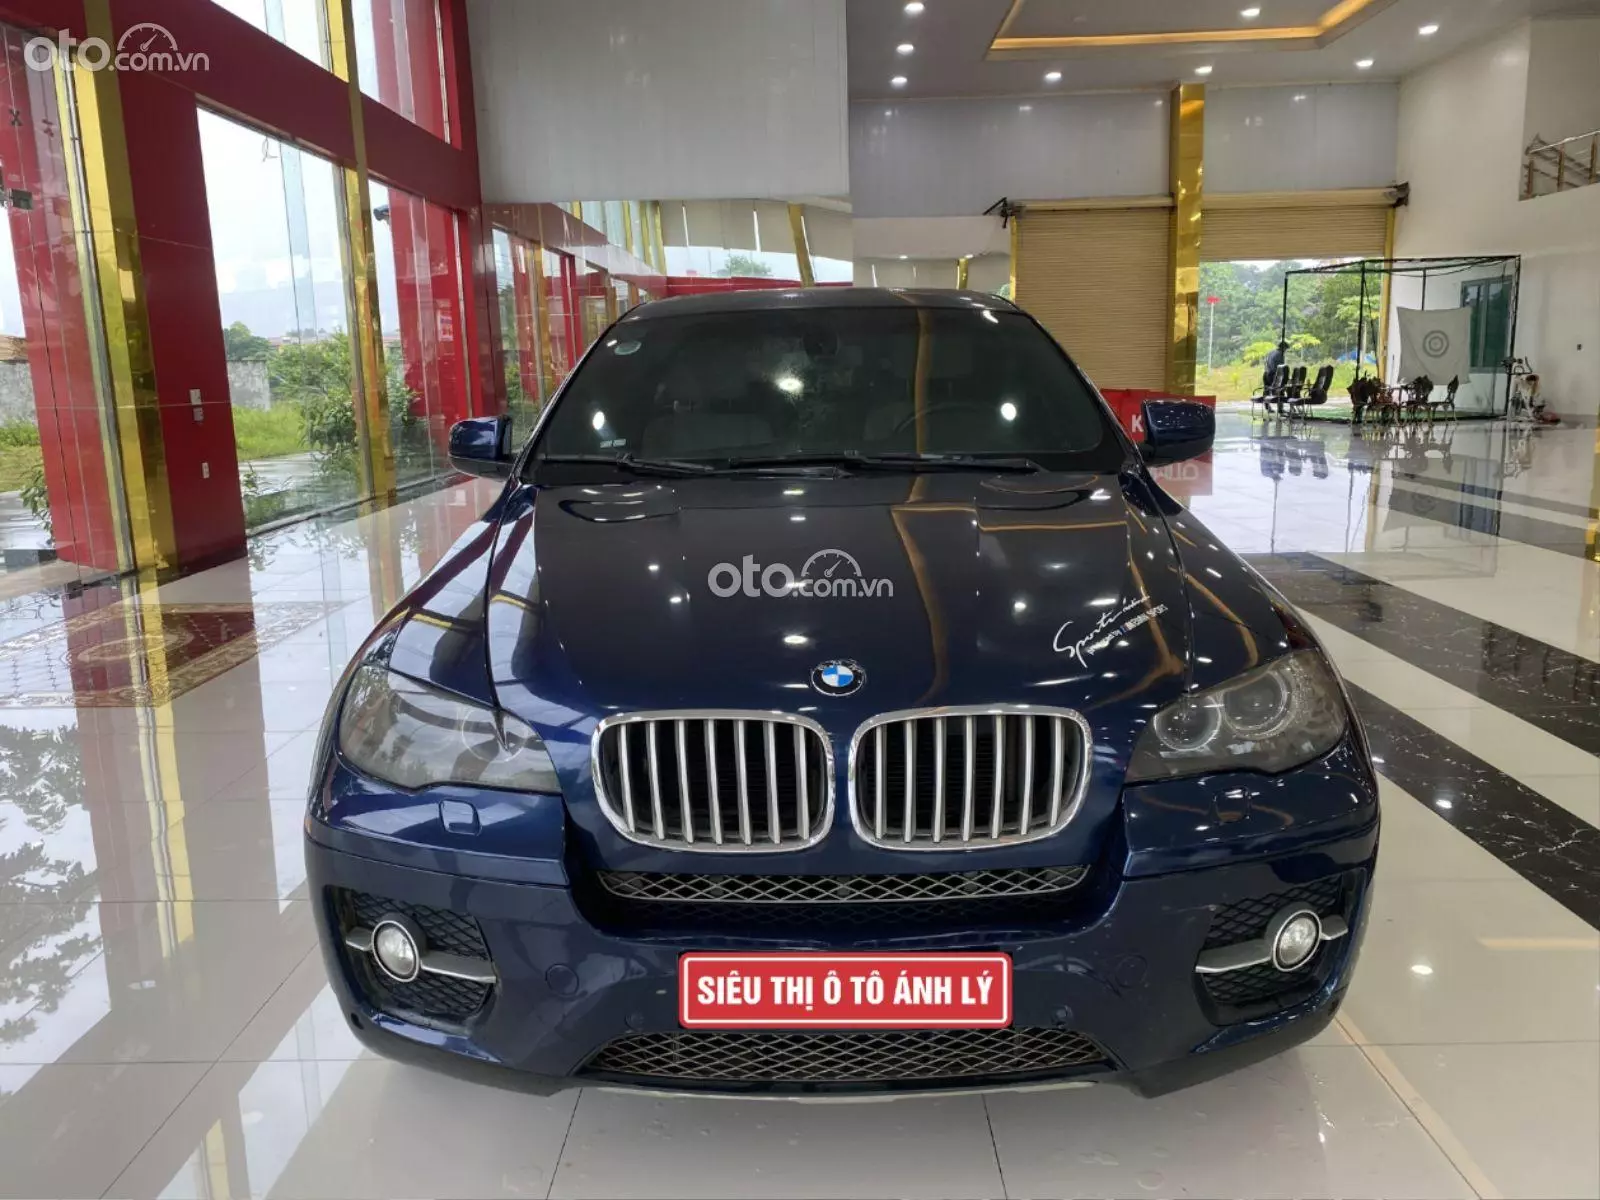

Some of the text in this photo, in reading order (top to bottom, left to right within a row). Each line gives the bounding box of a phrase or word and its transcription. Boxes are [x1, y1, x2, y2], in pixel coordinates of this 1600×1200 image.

[697, 969, 993, 1012] SIÊU THỊ Ô TÔ ÁNH LÝ
